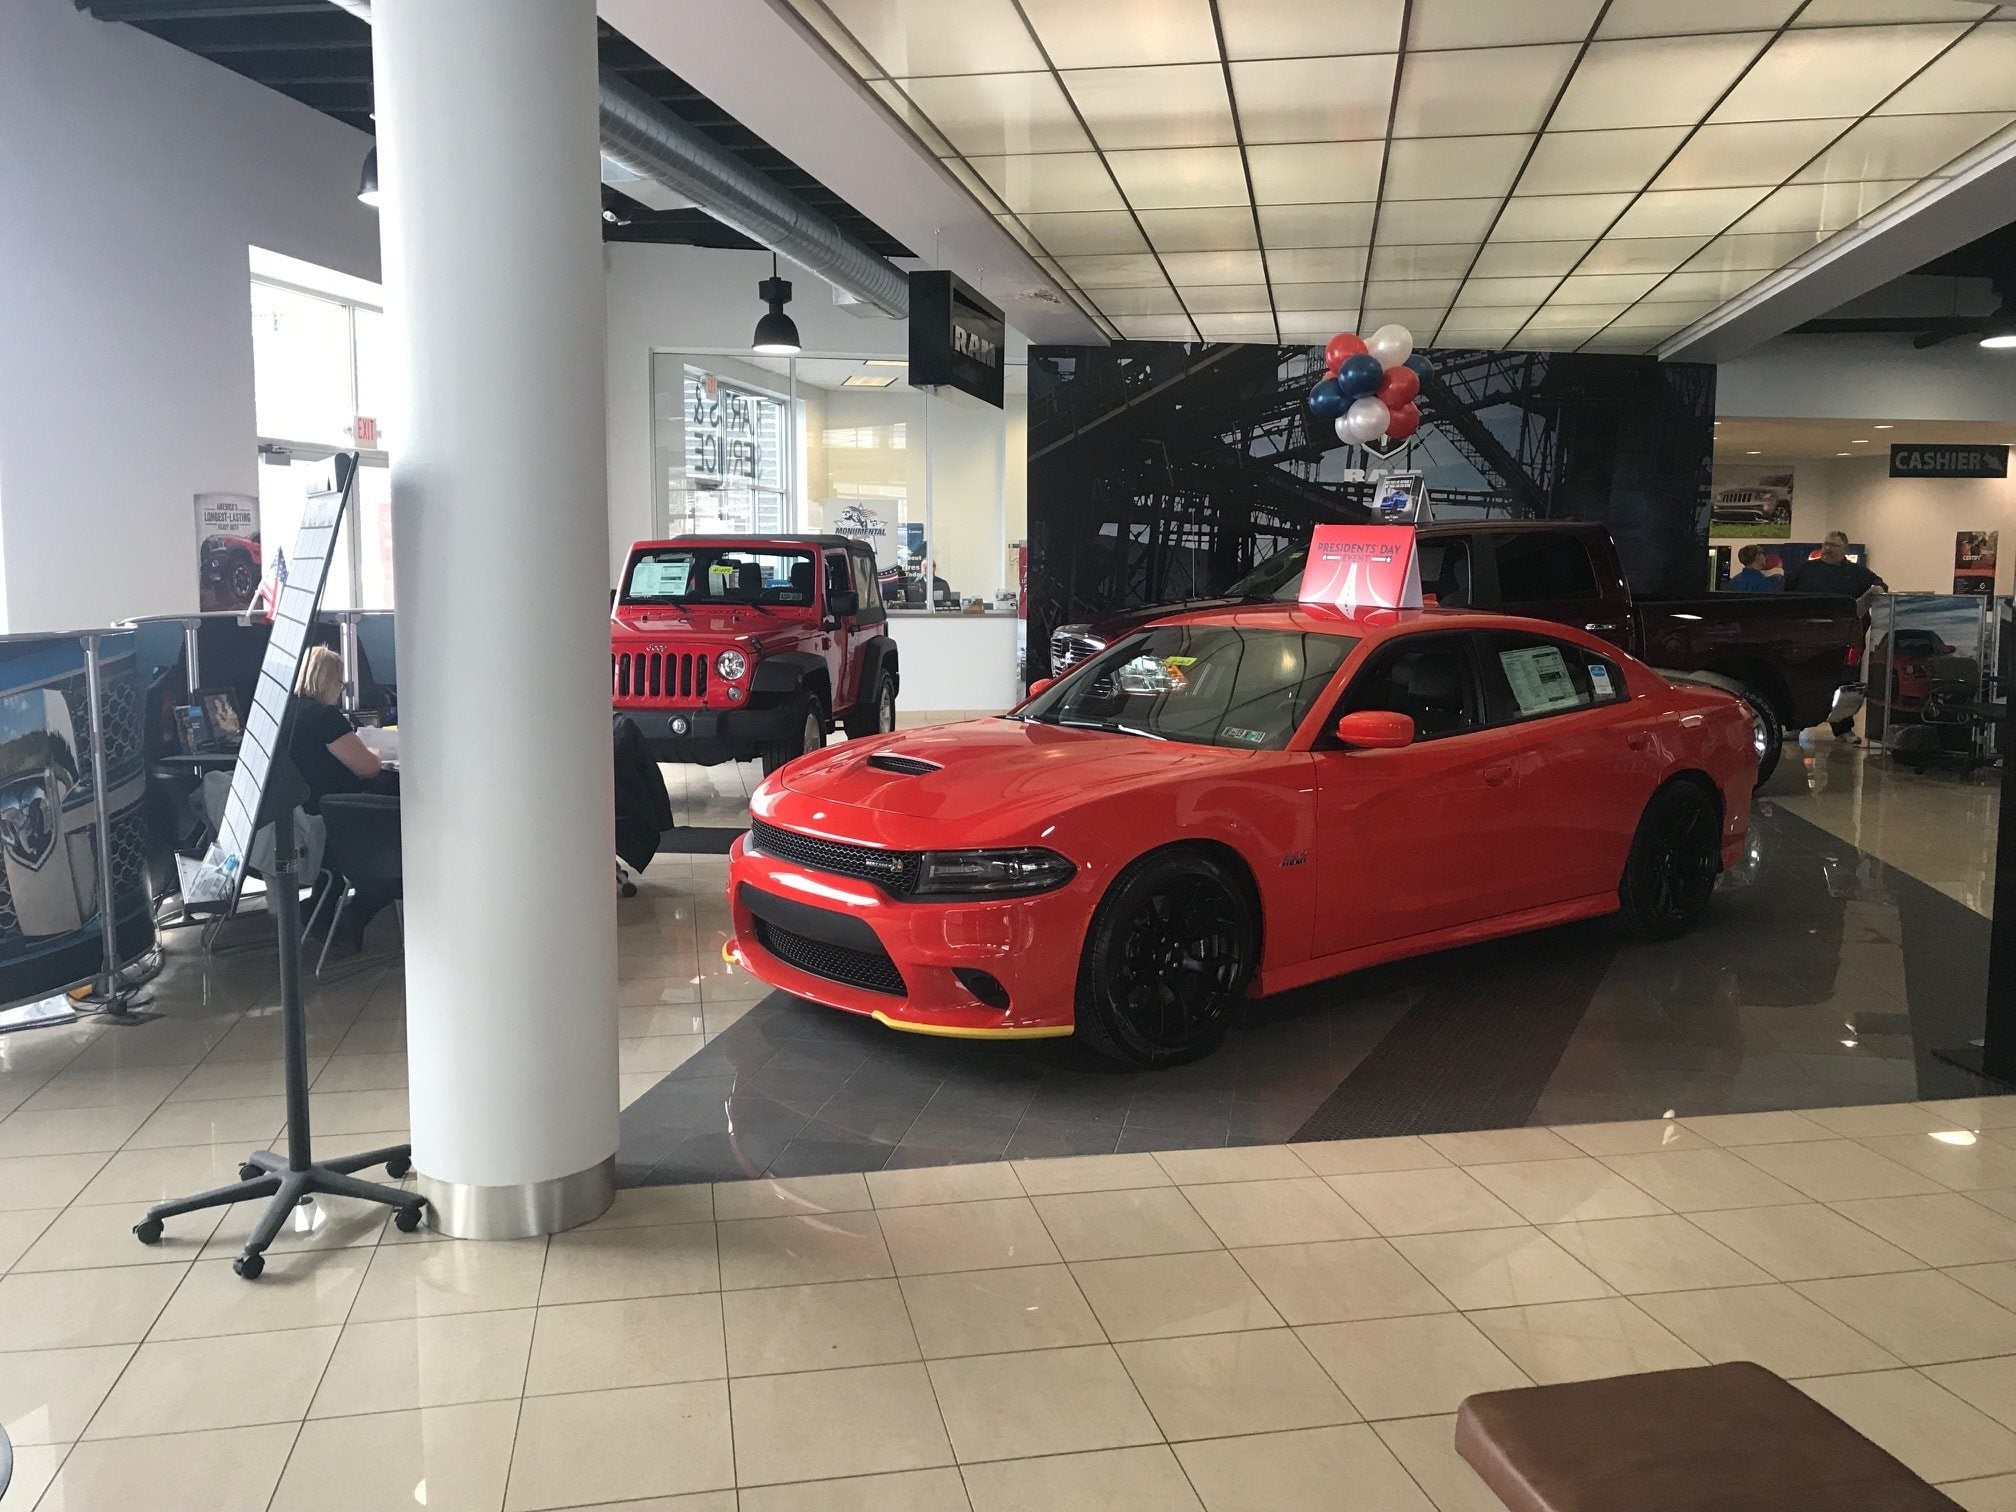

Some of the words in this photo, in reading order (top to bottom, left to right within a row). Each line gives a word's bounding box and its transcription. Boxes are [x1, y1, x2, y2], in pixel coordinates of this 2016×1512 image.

[953, 325, 996, 369] RAM
[357, 417, 375, 440] EXIT
[1895, 451, 1982, 470] CASHIER
[1344, 468, 1423, 483] RA
[204, 511, 251, 522] LONGEST-LASTING
[835, 527, 887, 536] MONUMENTAL
[1380, 544, 1402, 554] DAY
[1342, 554, 1370, 562] EVENT
